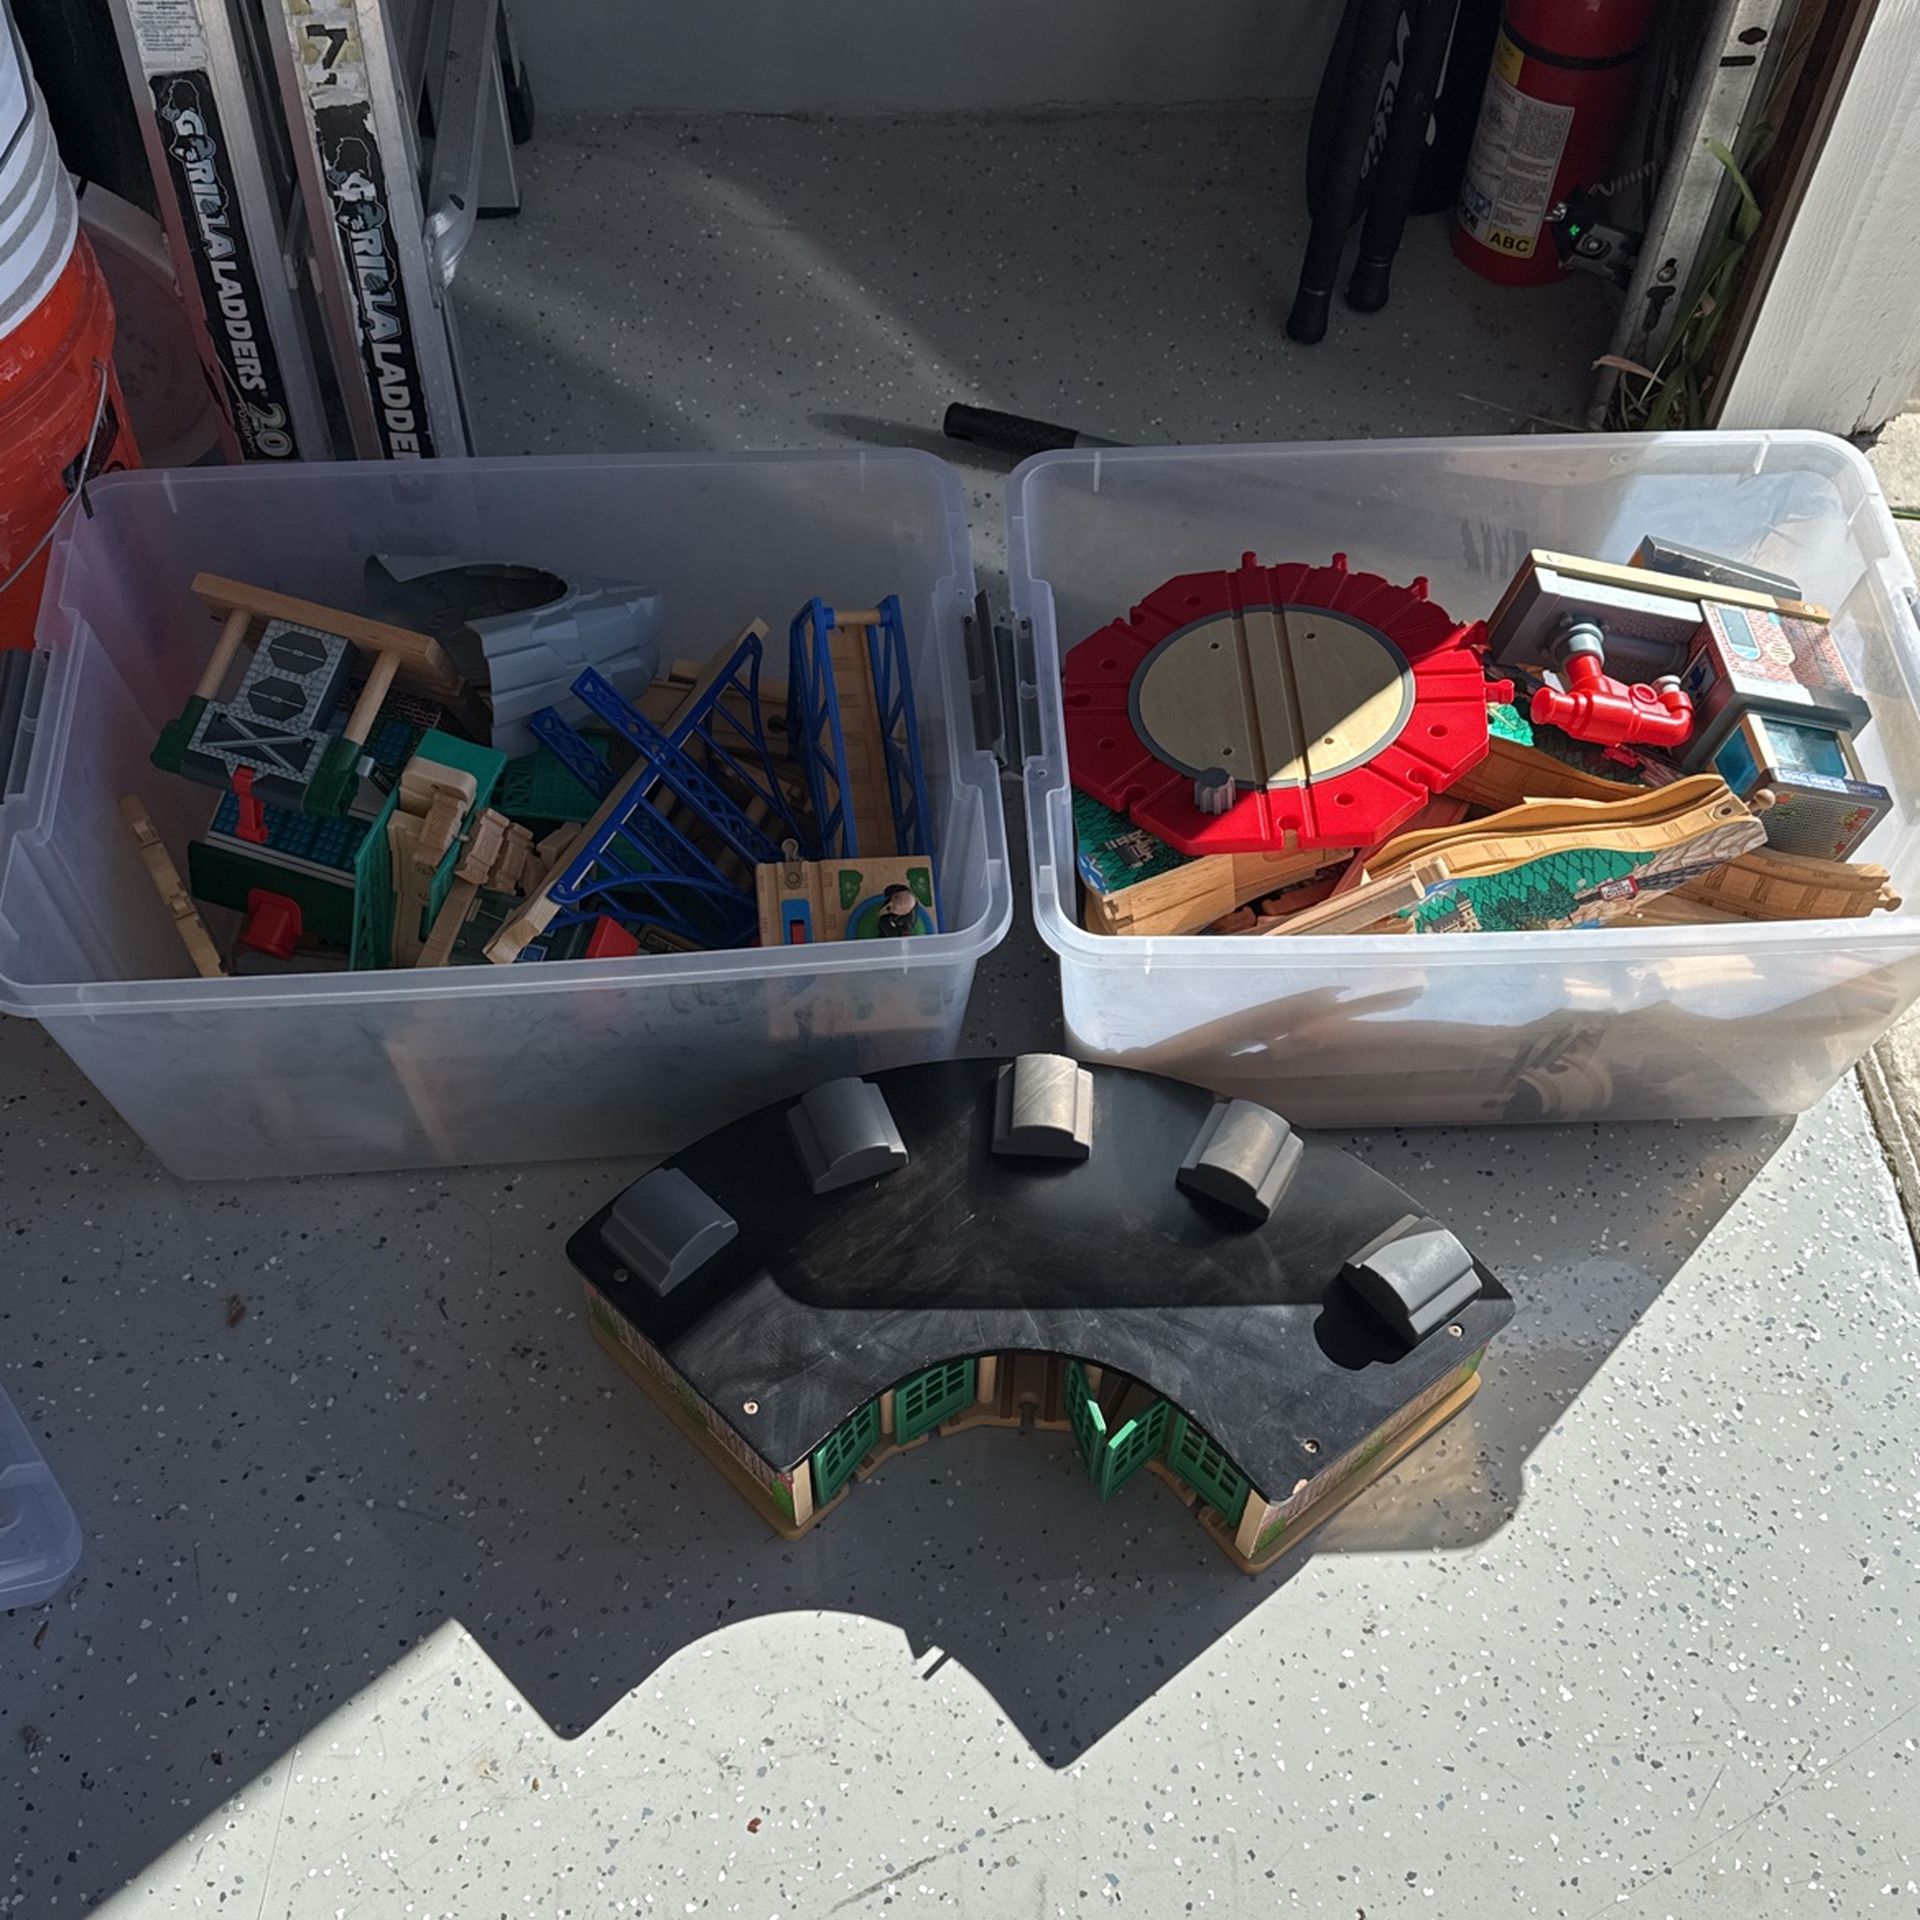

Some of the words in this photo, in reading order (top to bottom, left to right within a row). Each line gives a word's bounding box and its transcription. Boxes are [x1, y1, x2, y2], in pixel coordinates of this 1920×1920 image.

[1489, 231, 1530, 253] ABC
[209, 260, 267, 391] LADDERS
[247, 402, 293, 457] 20
